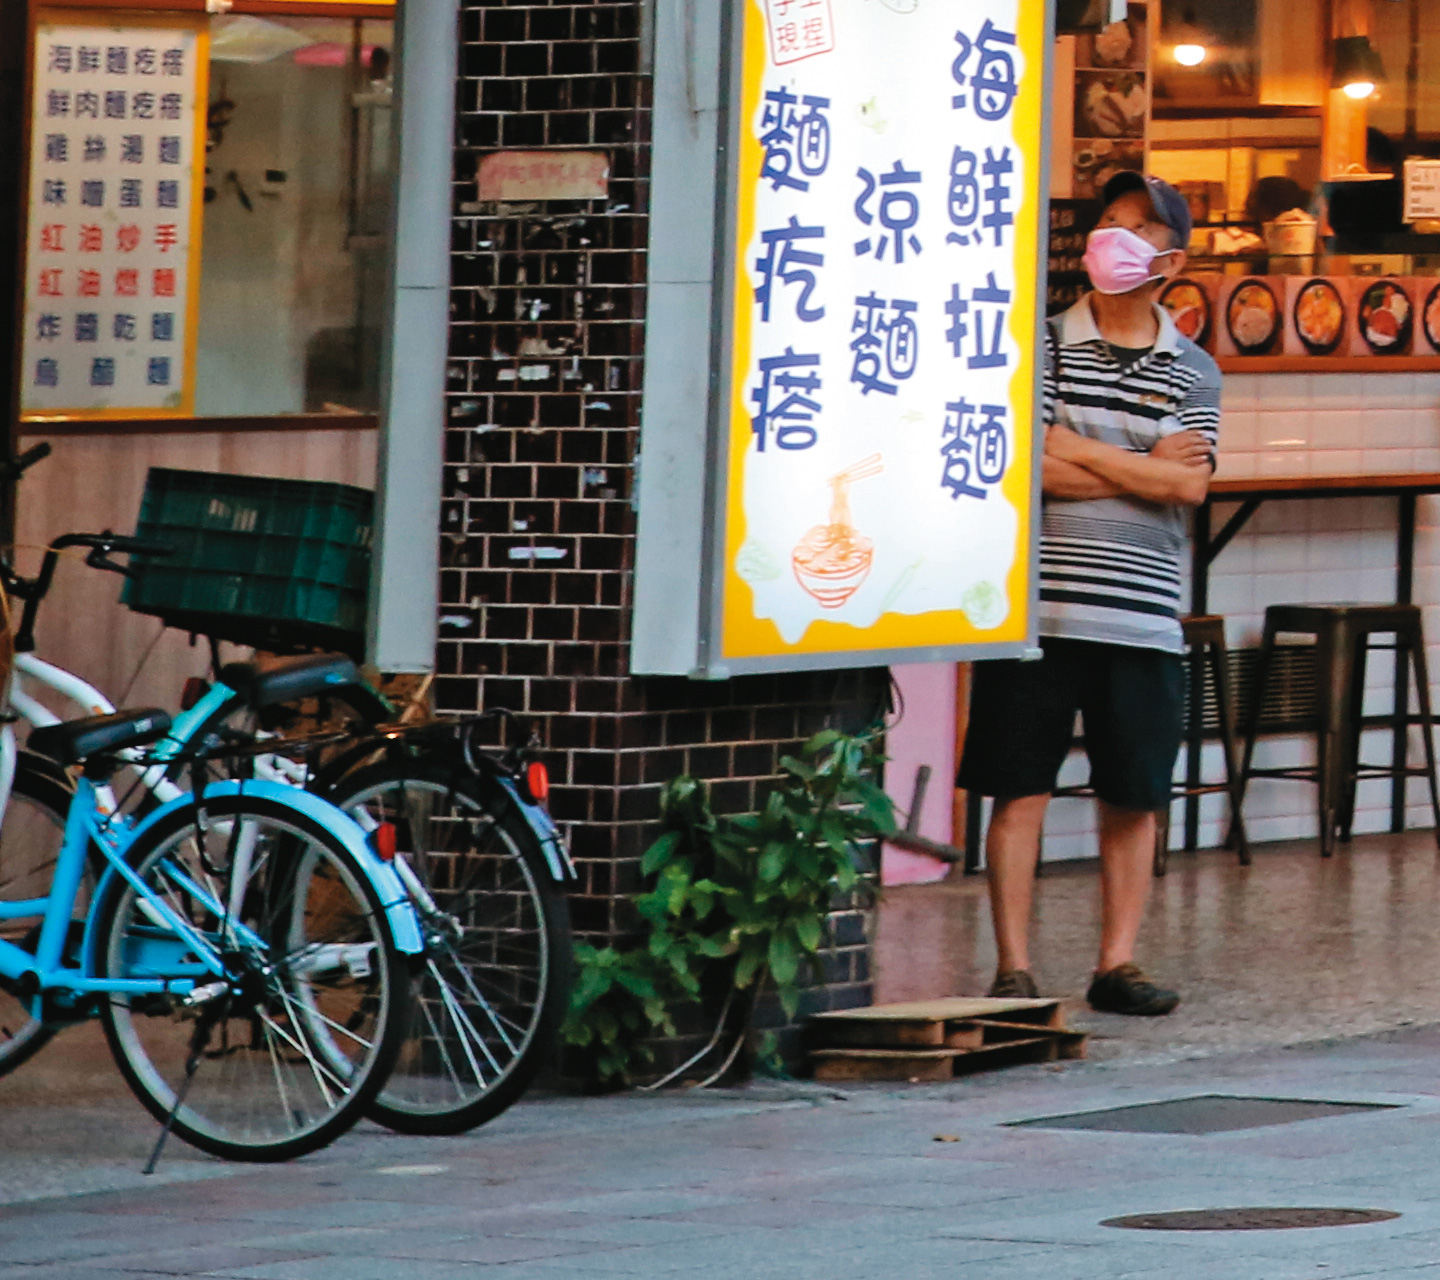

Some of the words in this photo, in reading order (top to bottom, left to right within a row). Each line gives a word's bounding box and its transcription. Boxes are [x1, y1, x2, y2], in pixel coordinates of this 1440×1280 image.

[46, 90, 182, 120] 鮮肉麵疙瘩
[47, 46, 184, 76] 海鮮麵疙瘩
[751, 84, 832, 454] 麵疙瘩
[849, 159, 924, 398] 涼麵
[940, 18, 1020, 502] 海鮮拉麵
